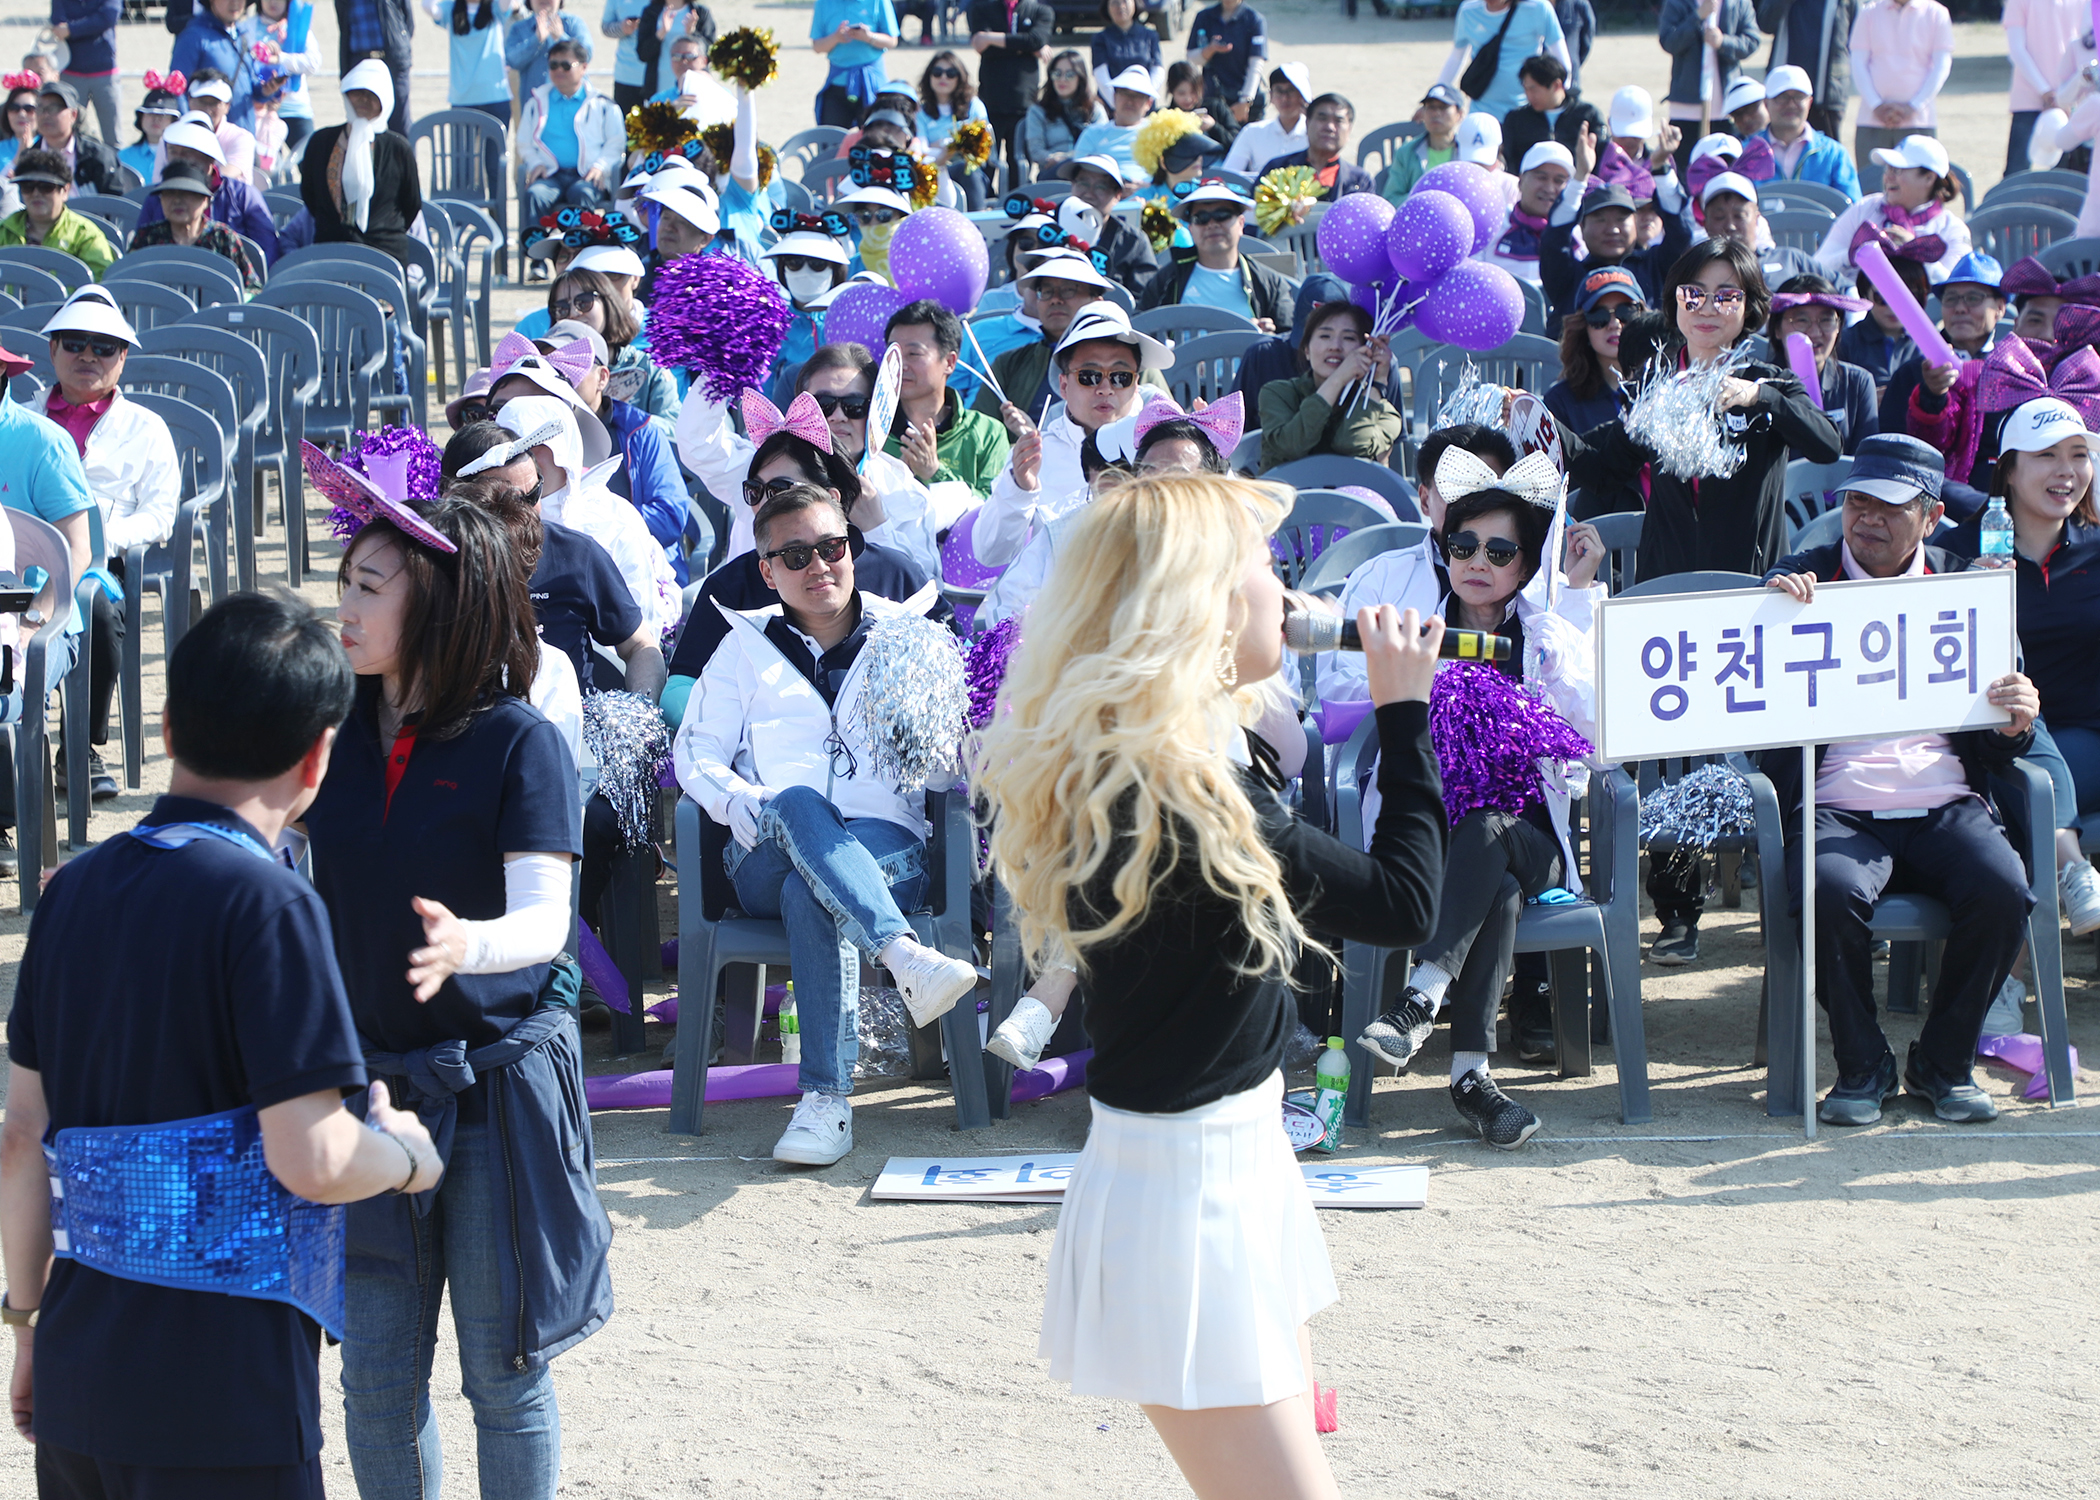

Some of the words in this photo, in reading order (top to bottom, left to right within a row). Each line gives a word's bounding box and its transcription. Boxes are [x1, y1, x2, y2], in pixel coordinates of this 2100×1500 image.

[1472, 132, 1484, 145] A
[529, 592, 550, 600] PING
[1641, 608, 1978, 722] 양천구의회
